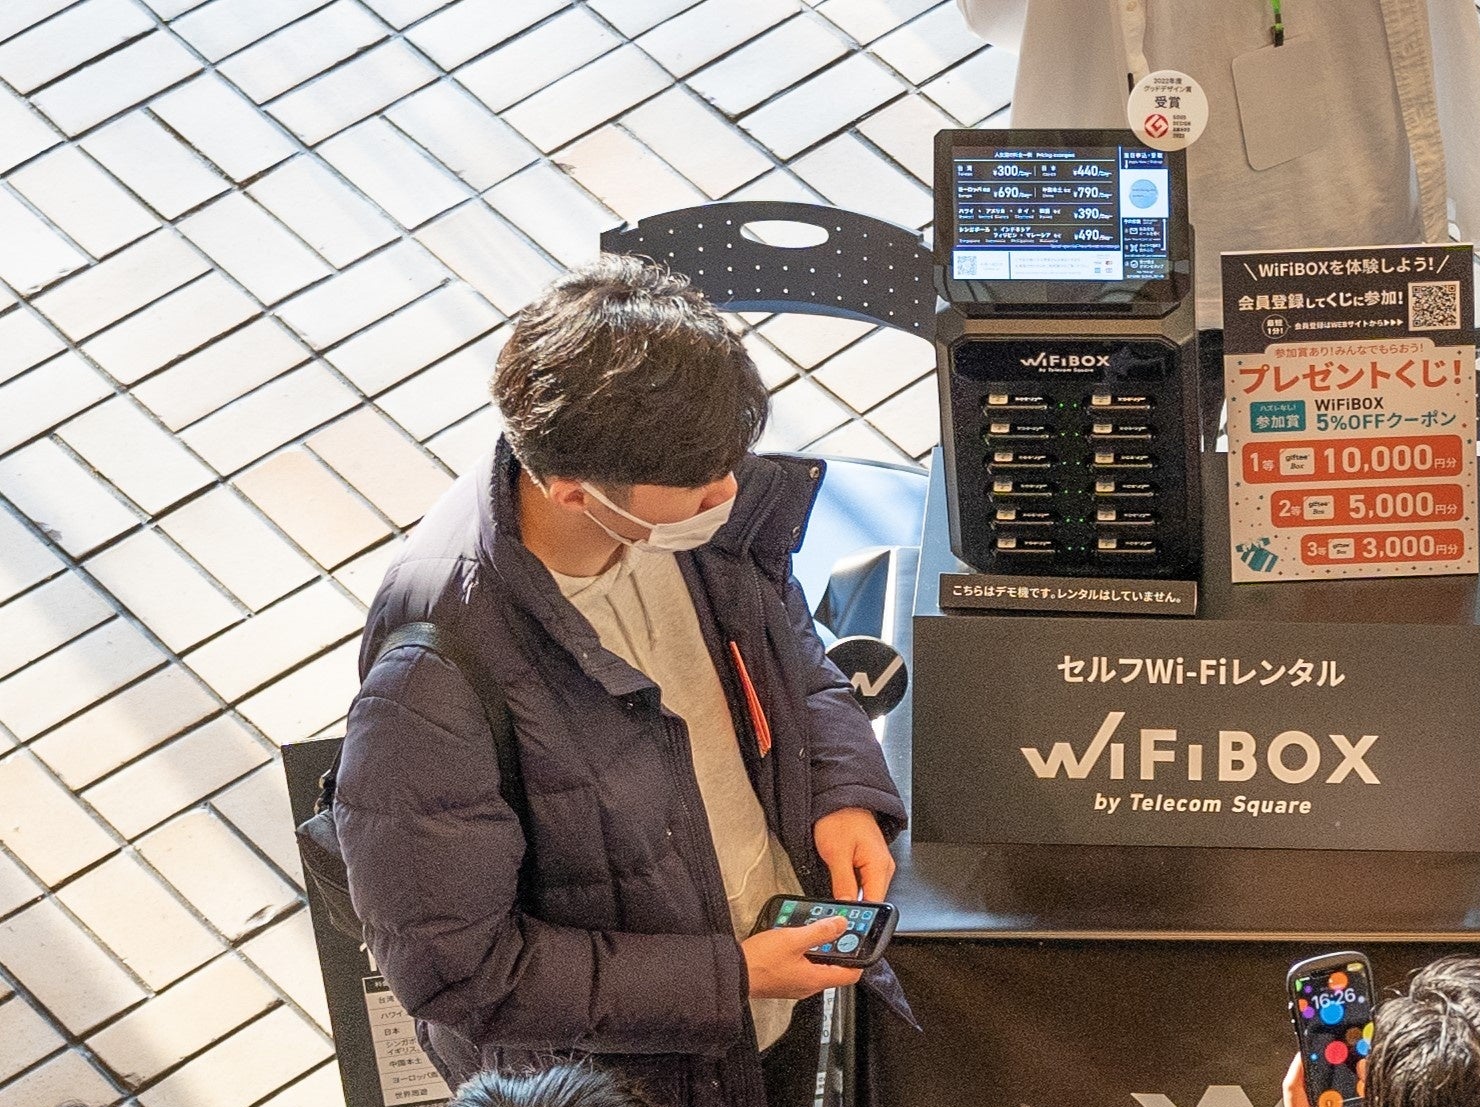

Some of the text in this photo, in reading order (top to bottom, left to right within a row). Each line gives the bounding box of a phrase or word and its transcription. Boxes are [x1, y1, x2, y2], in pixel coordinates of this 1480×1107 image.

[1154, 95, 1181, 109] 受賞
[1258, 256, 1434, 278] WiFiBOXを体験しよう!
[1238, 289, 1404, 312] 会員登録してくじに参加!
[1275, 343, 1424, 359] 参加賞あり!みんなでもらおう!
[1238, 359, 1462, 395] プレゼントくじ!
[1315, 397, 1384, 412] WiFiBOX
[1256, 414, 1300, 429] 参加賞
[1316, 409, 1456, 432] 5%OFFクーポン
[952, 584, 1182, 604] こちらはデモ機です。レンタルはしていません。
[1056, 653, 1346, 689] セルフWi-Fiレンタル
[1094, 792, 1313, 818] by Telecom Square
[1310, 987, 1357, 1010] 16:26
[380, 1011, 402, 1020] ハワイ
[384, 1028, 400, 1036] 日本
